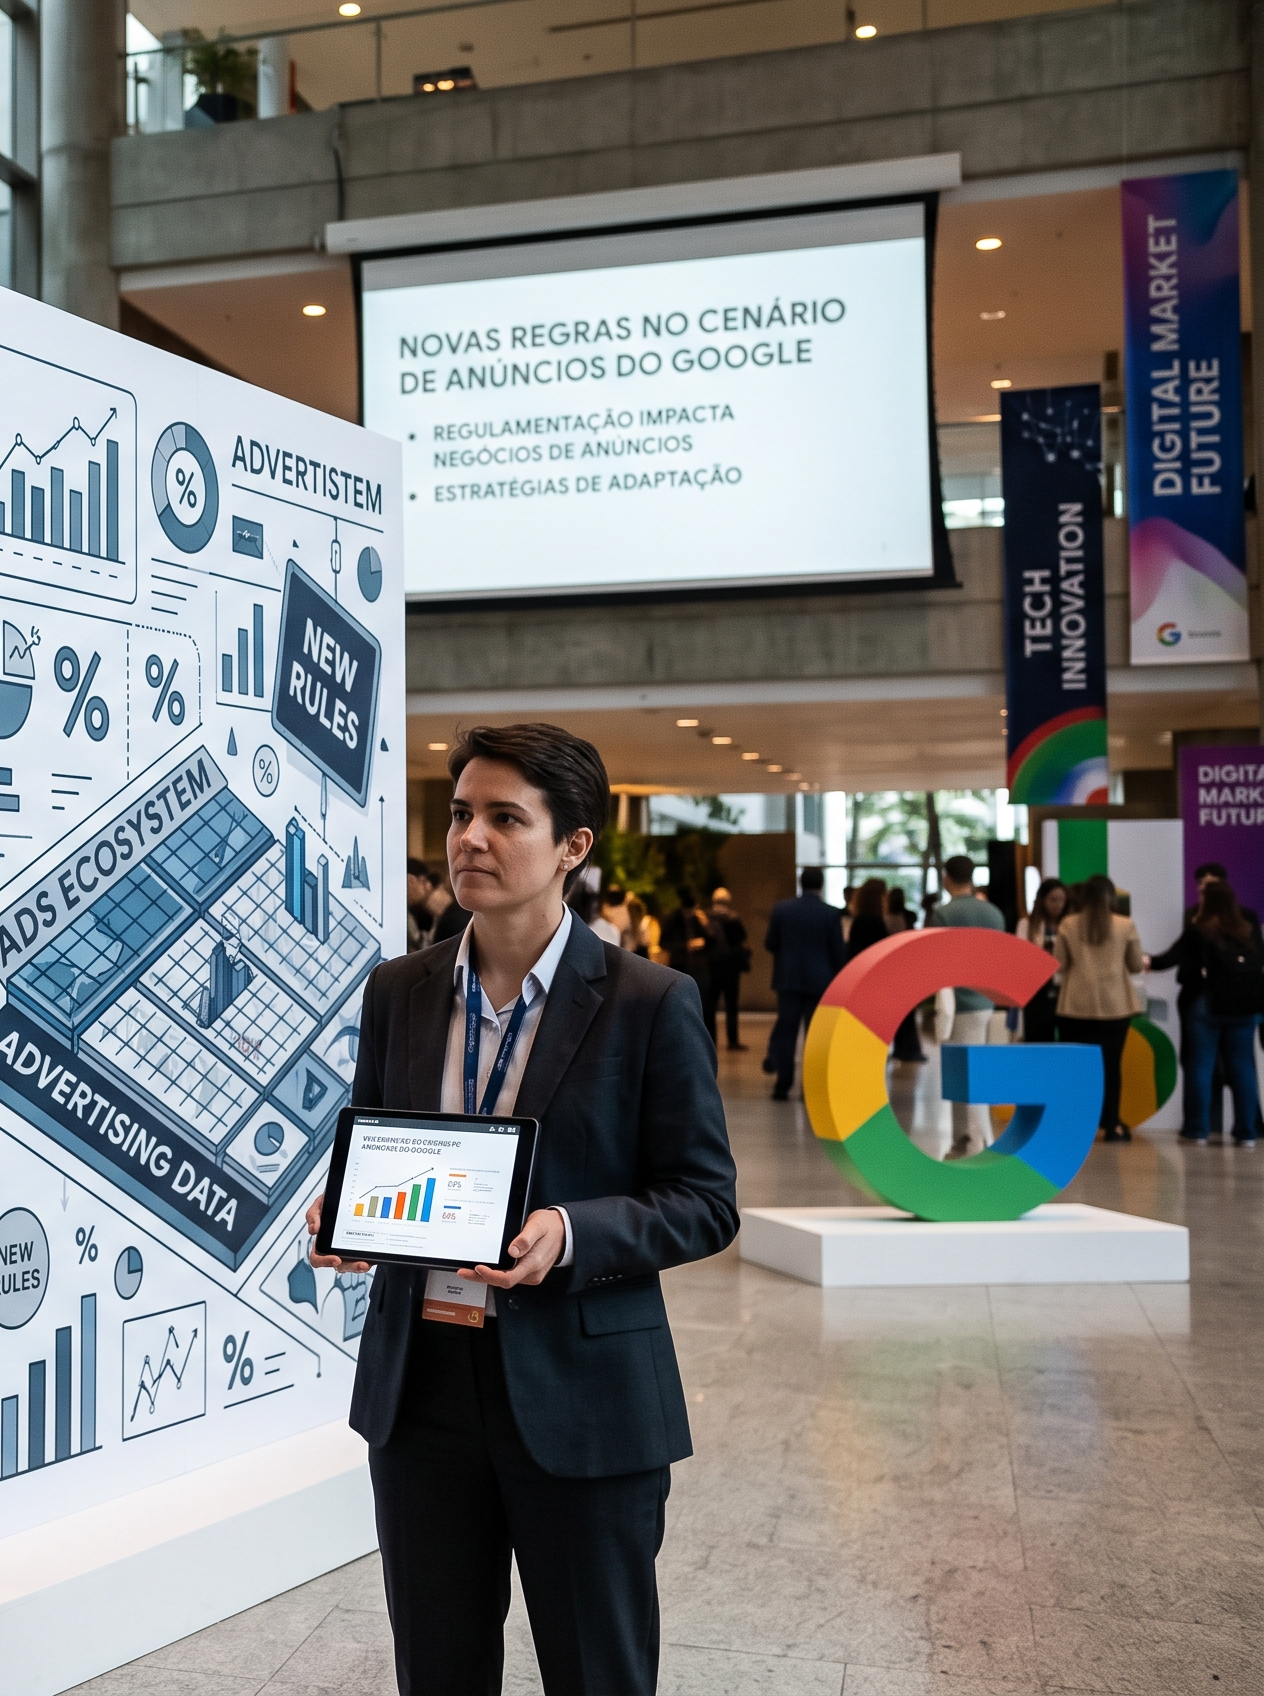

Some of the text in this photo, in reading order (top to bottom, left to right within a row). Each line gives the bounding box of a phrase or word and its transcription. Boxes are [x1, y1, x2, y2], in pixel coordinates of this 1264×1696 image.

[399, 296, 847, 360] NOVAS REGRAS NO CENÁRIO
[400, 338, 814, 395] DE ANÚNCIOS DO GOOGLE
[1147, 214, 1183, 498] DIGITAL MARKET
[433, 403, 735, 442] REGULAMENTAÇÃO IMPACTA
[433, 431, 694, 469] NEGÓCIOS DE ANÚNCIOS
[1189, 357, 1222, 496] FUTURE
[231, 434, 383, 516] ADVERTISTEM
[433, 464, 742, 503] ESTRATÉGIAS DE ADAPTAÇÃO
[1023, 569, 1053, 658] TECH
[1058, 502, 1086, 690] INNOVATION
[302, 617, 358, 692] NEW
[289, 661, 359, 750] RULES
[57, 757, 213, 911] ECOSYSTEM
[171, 1158, 239, 1232] DATA
